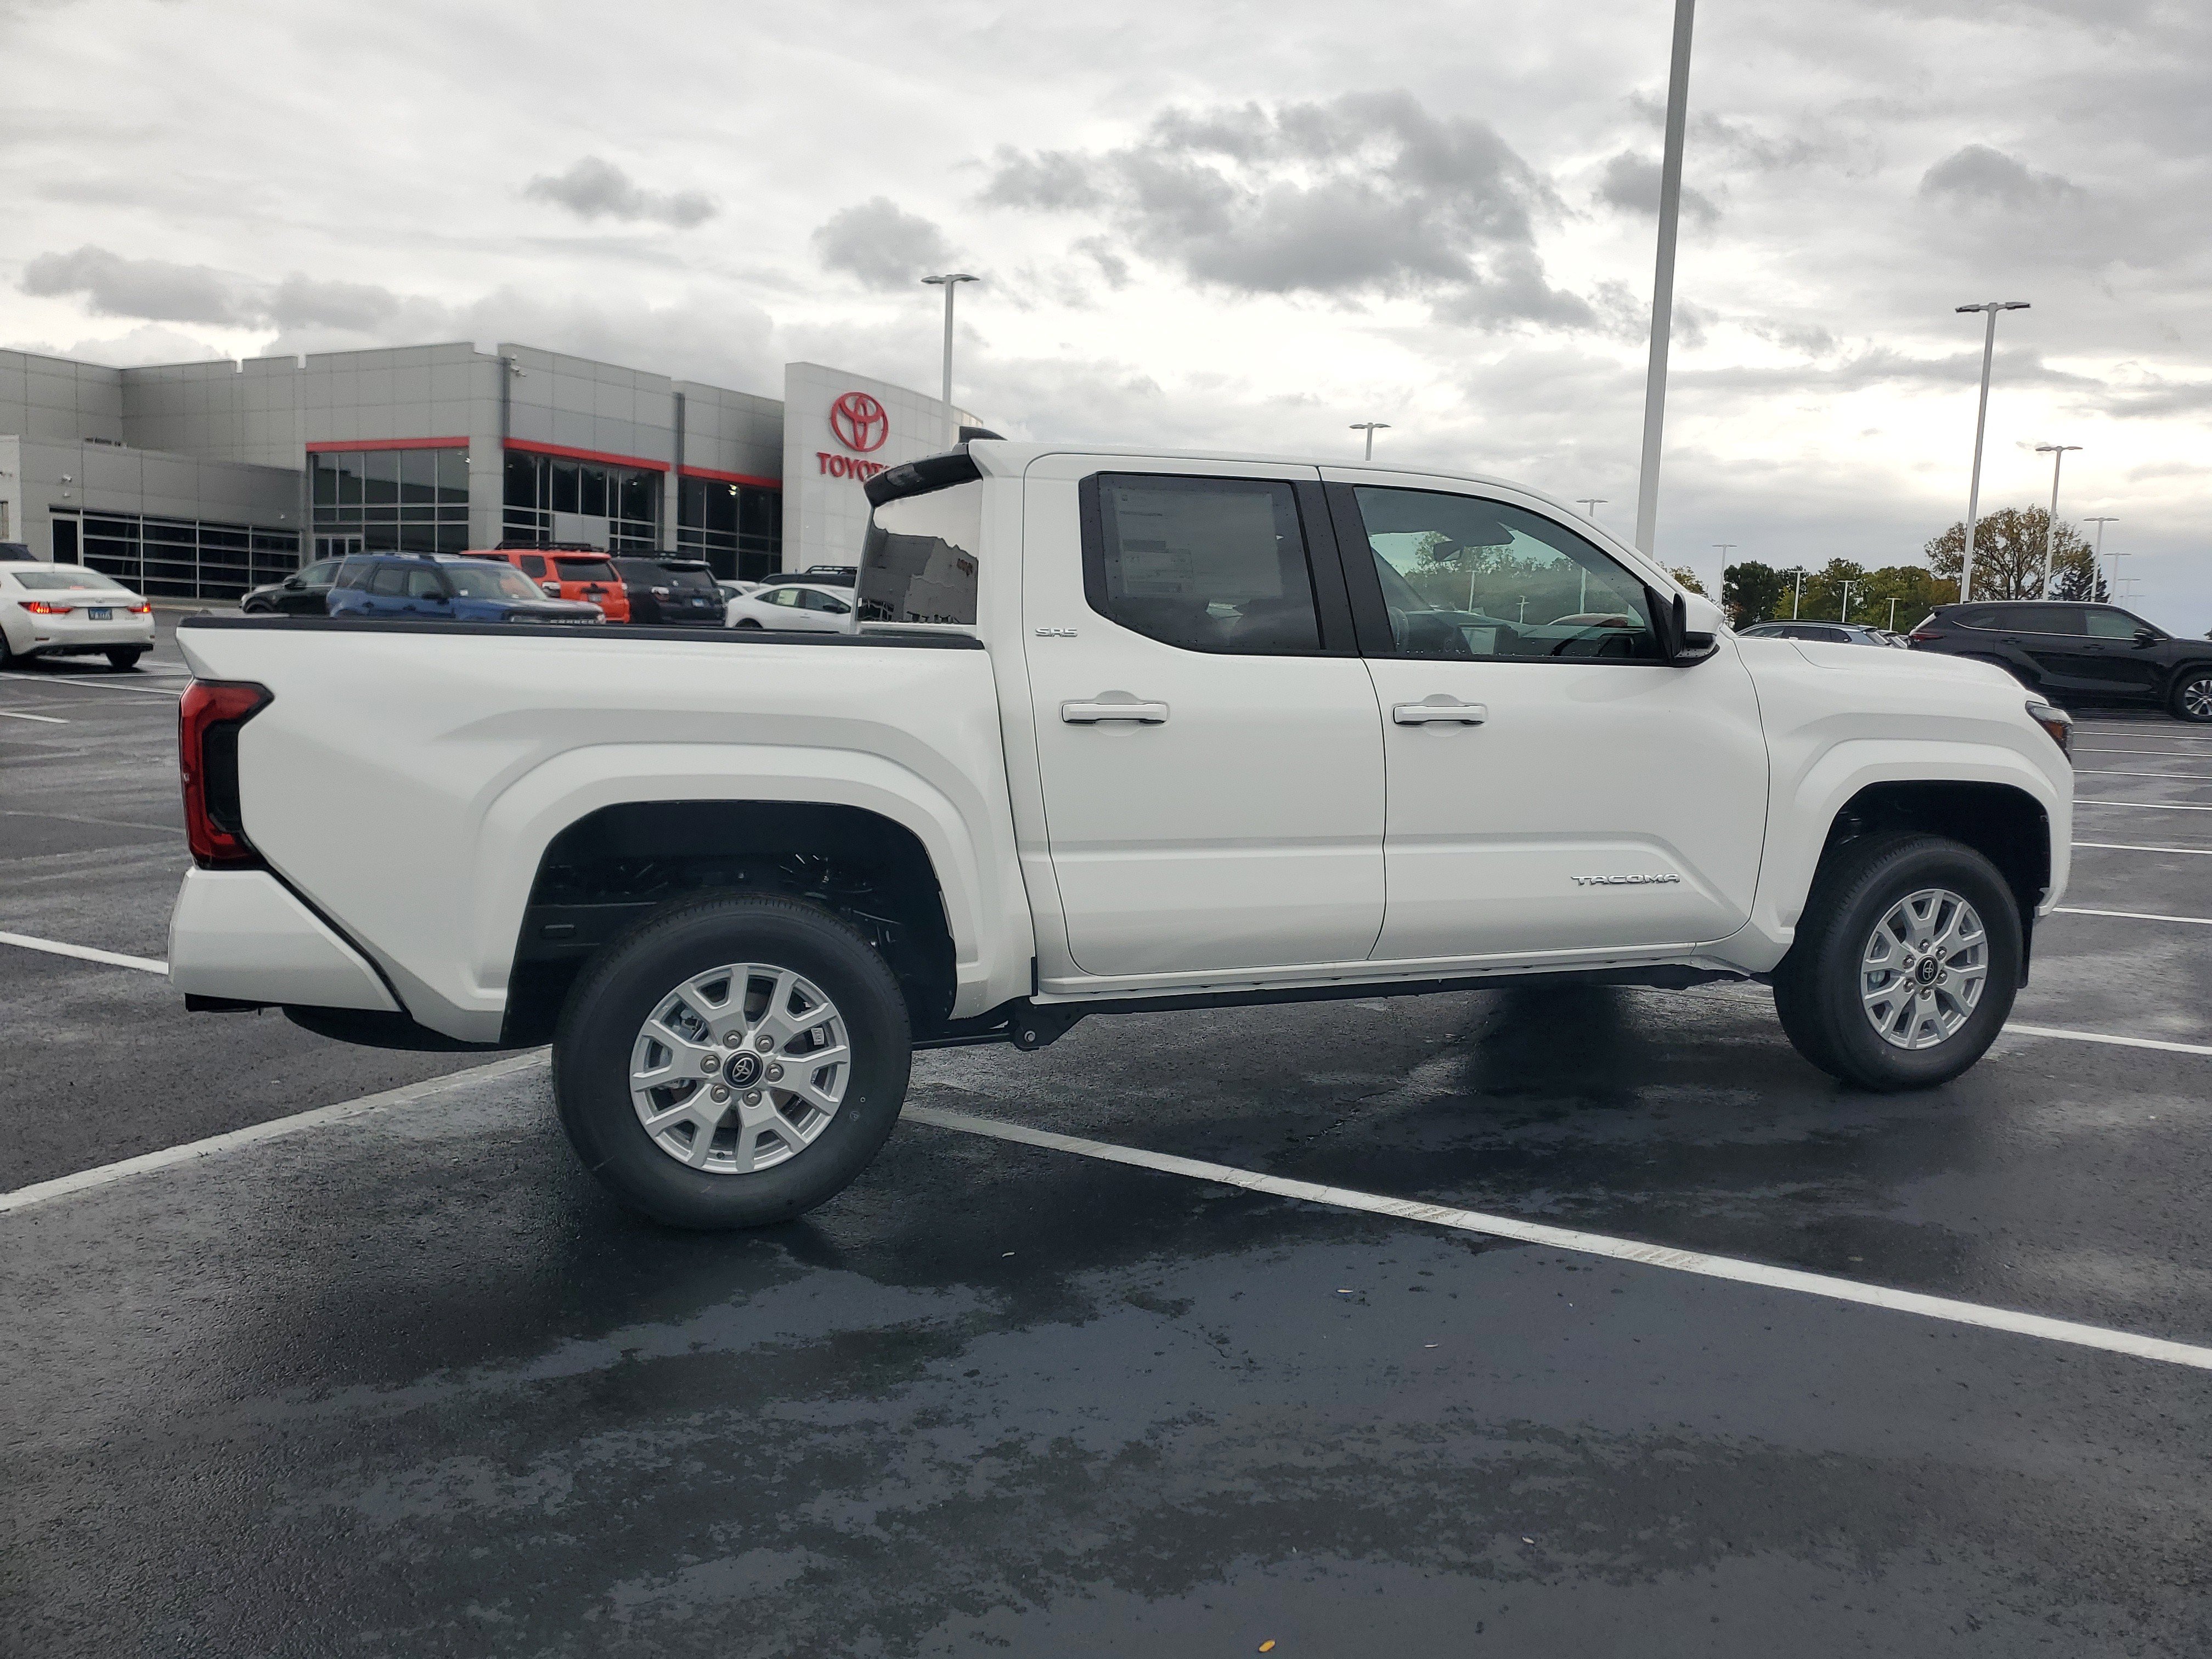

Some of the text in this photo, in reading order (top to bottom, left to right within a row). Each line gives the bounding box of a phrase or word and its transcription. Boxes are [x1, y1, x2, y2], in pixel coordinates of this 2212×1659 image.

[816, 452, 890, 482] TOYOT
[1035, 628, 1077, 637] SR5
[1570, 873, 1680, 885] TACOMA
